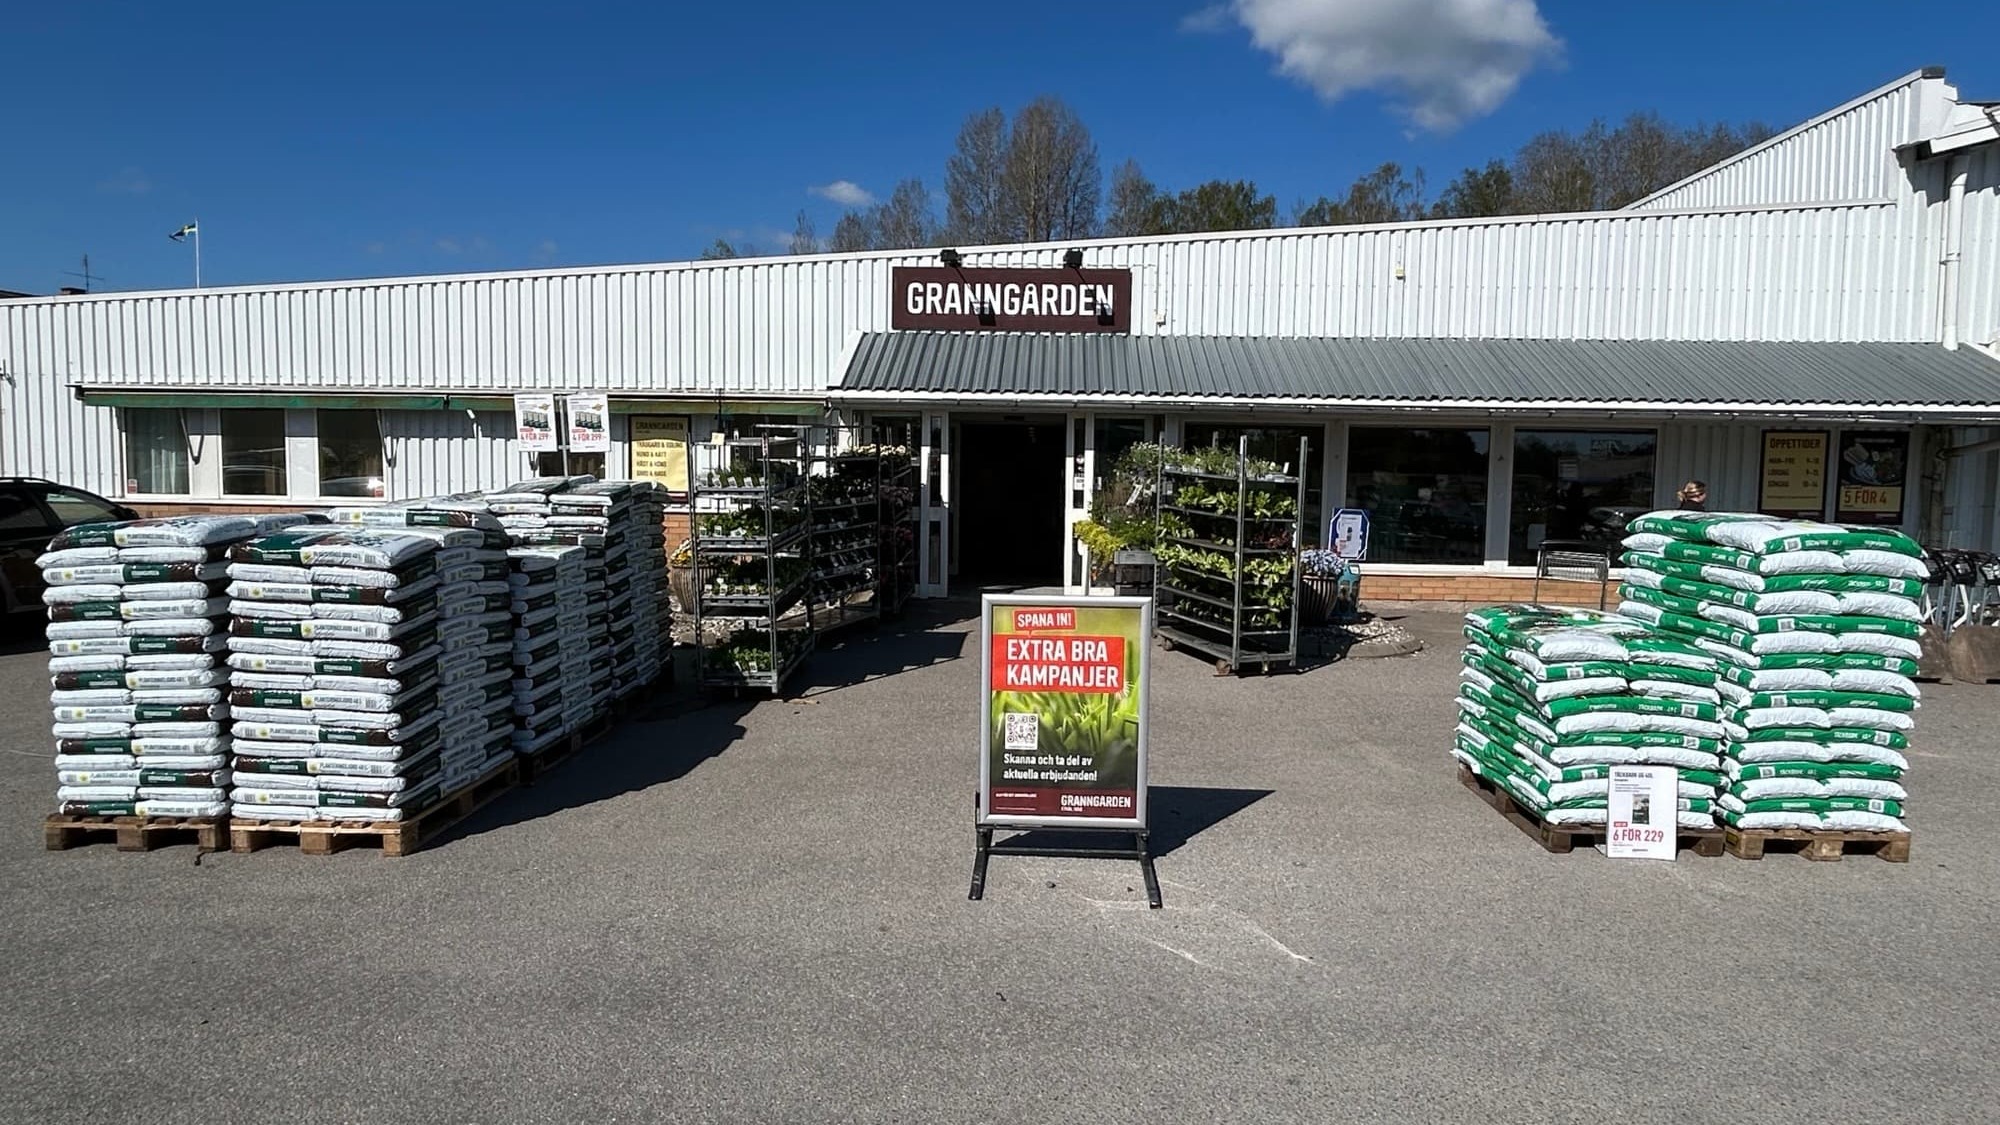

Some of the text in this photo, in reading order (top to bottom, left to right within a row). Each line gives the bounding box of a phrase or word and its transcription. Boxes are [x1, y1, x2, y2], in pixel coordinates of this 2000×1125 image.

[907, 282, 1114, 316] GRANNGÅRDEN
[1844, 491, 1887, 504] 5 FÖR 4
[1017, 612, 1072, 628] SPANA IN!
[1007, 639, 1108, 662] EXTRA BRA
[1007, 664, 1119, 688] KAMPANJER
[1003, 753, 1093, 766] Skanna och ta del av
[1003, 768, 1098, 783] aktuella erbjudanden!
[1613, 828, 1664, 843] 6 FÖR 229
